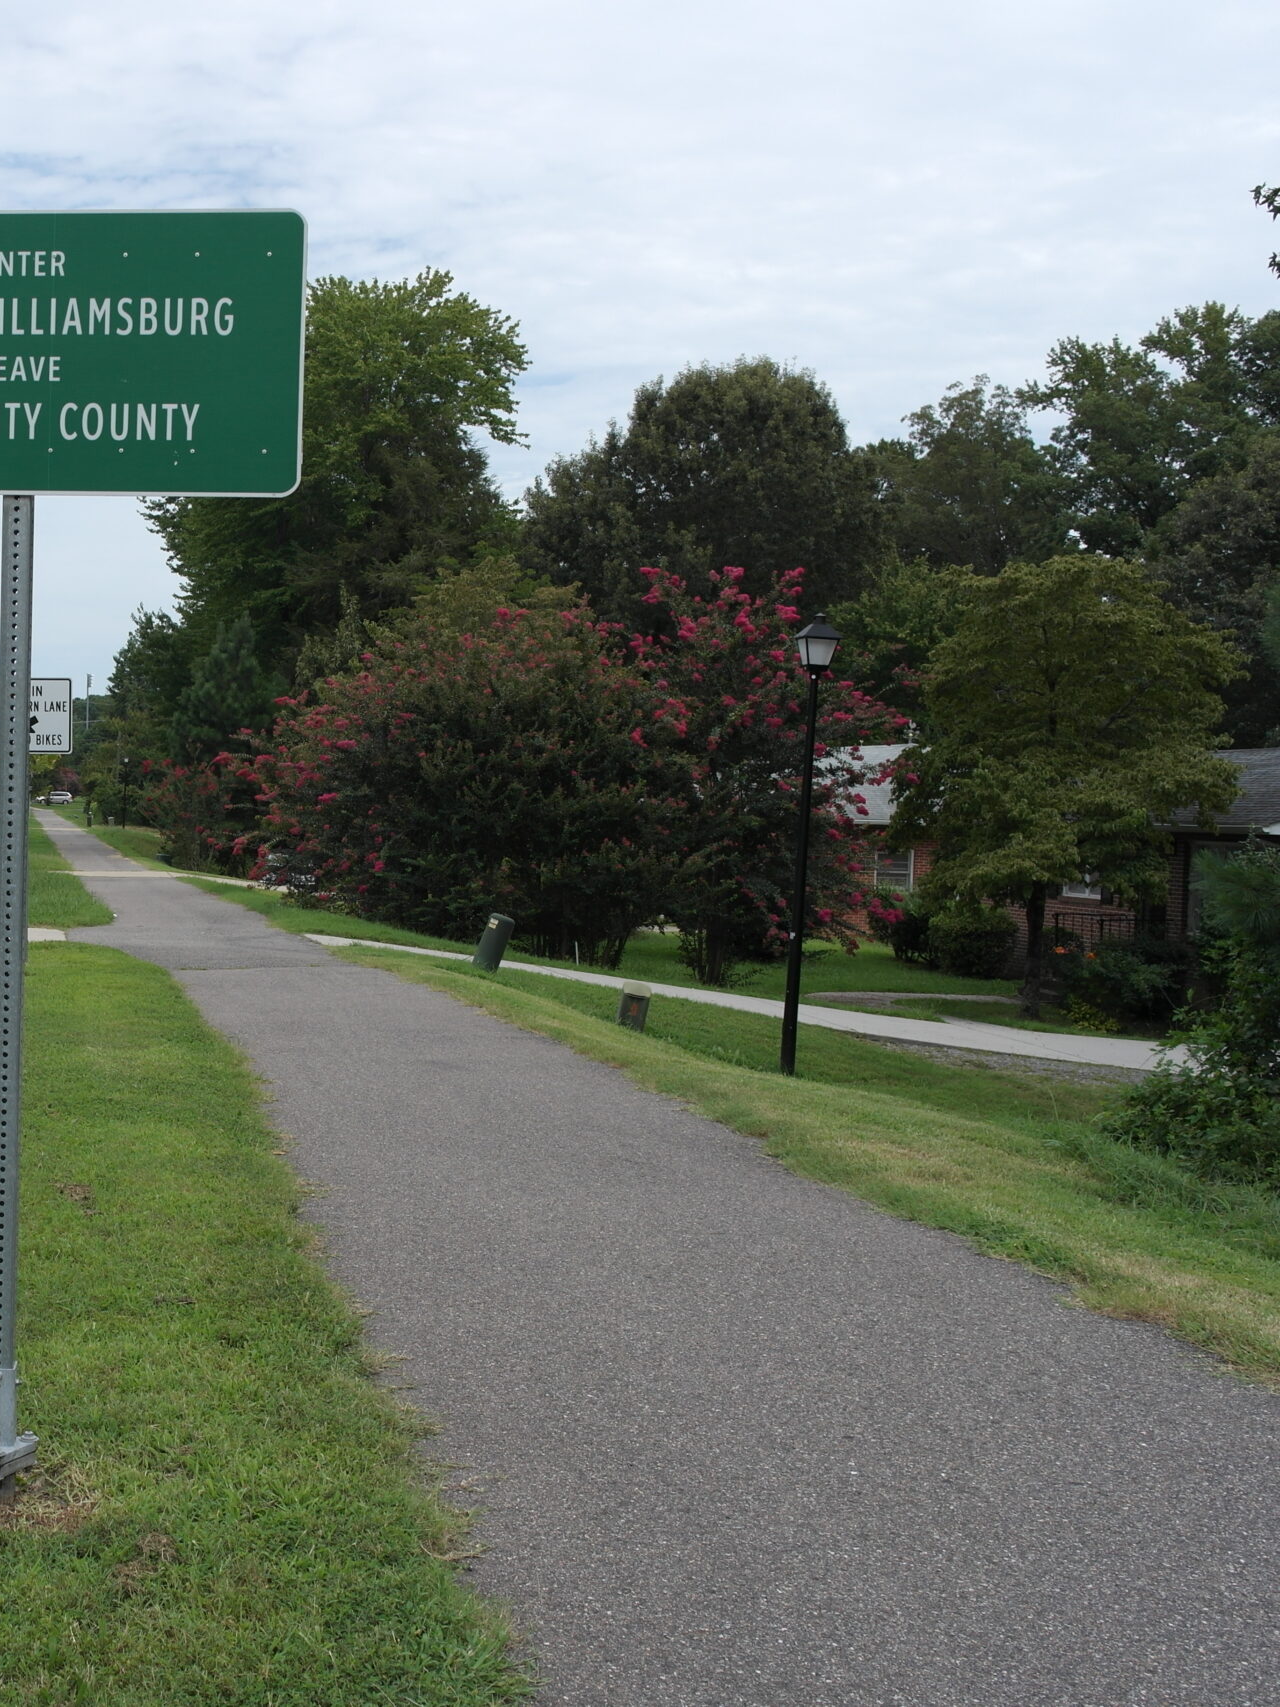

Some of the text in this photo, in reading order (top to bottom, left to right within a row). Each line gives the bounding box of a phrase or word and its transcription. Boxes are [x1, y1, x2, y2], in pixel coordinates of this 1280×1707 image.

[59, 402, 200, 441] COUNTY
[44, 701, 67, 712] LANE
[36, 734, 62, 746] BIKES
